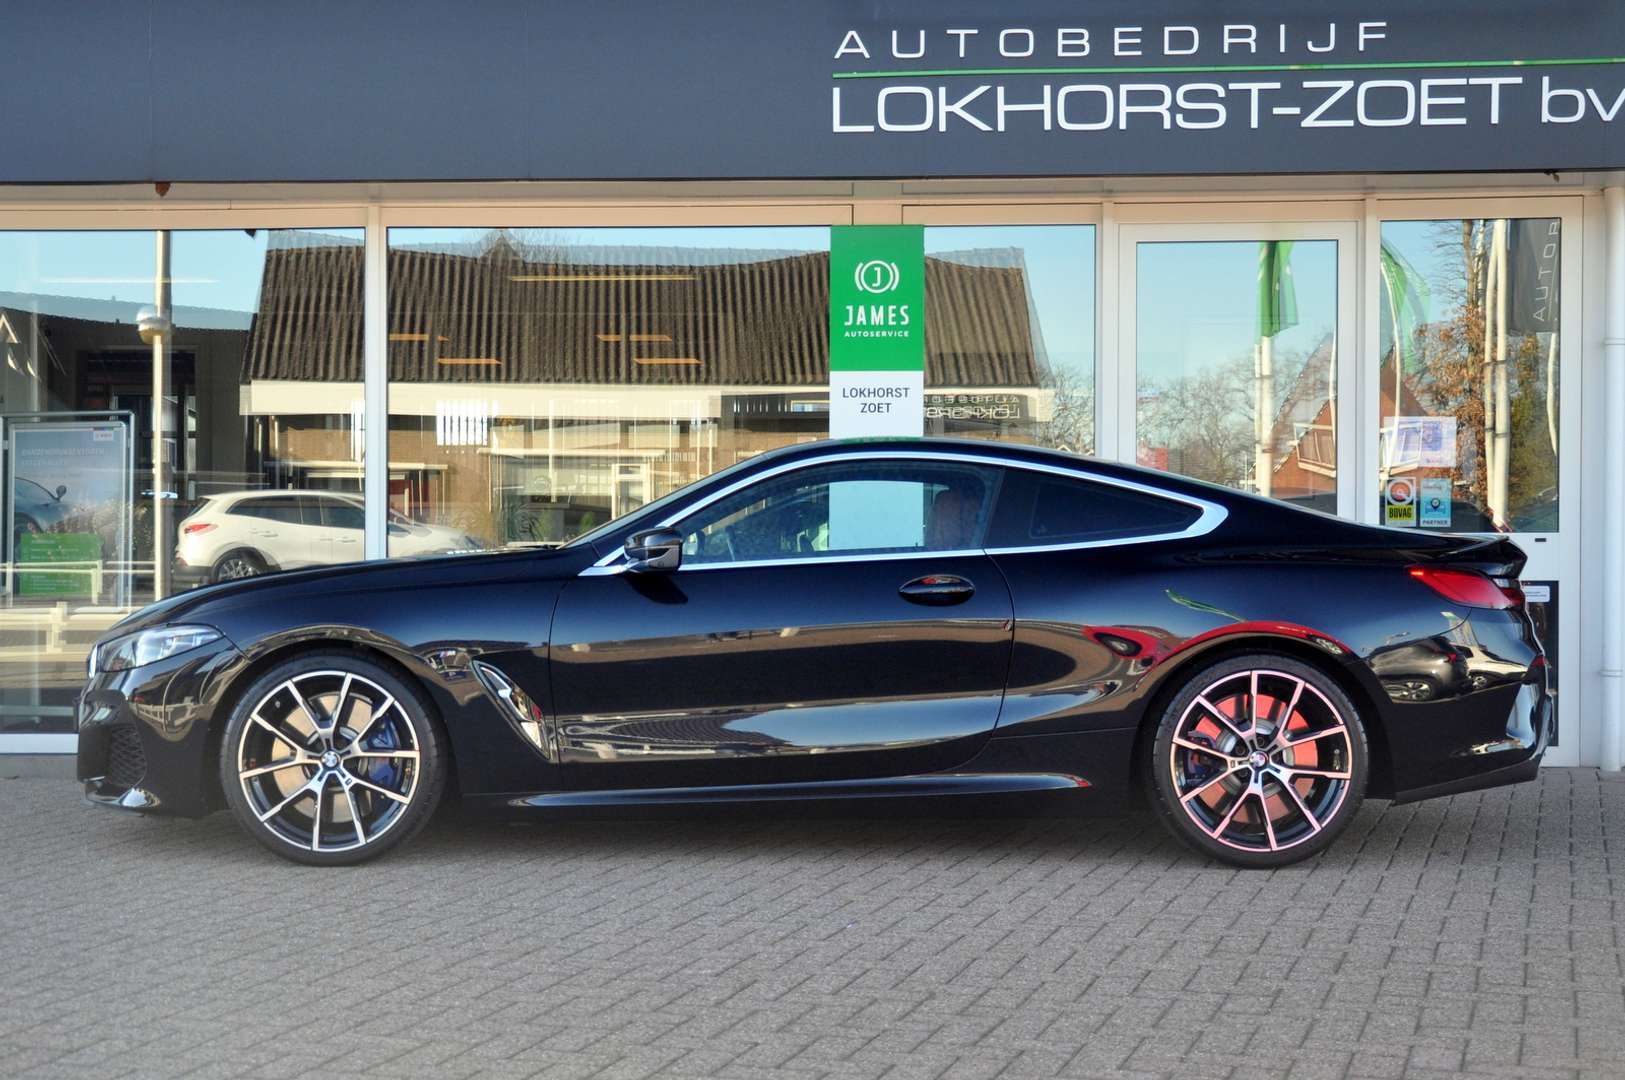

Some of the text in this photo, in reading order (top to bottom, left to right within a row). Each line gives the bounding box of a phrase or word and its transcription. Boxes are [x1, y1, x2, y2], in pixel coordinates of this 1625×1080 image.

[834, 22, 1387, 59] AUTOBEDRIJF
[832, 75, 1625, 133] LOKHORST-ZOET bv
[844, 304, 910, 326] JAMES
[844, 330, 909, 338] AUTOSERVICE
[842, 387, 910, 399] LOKHORST
[860, 402, 892, 414] ZOET
[1389, 507, 1412, 519] BOVAG
